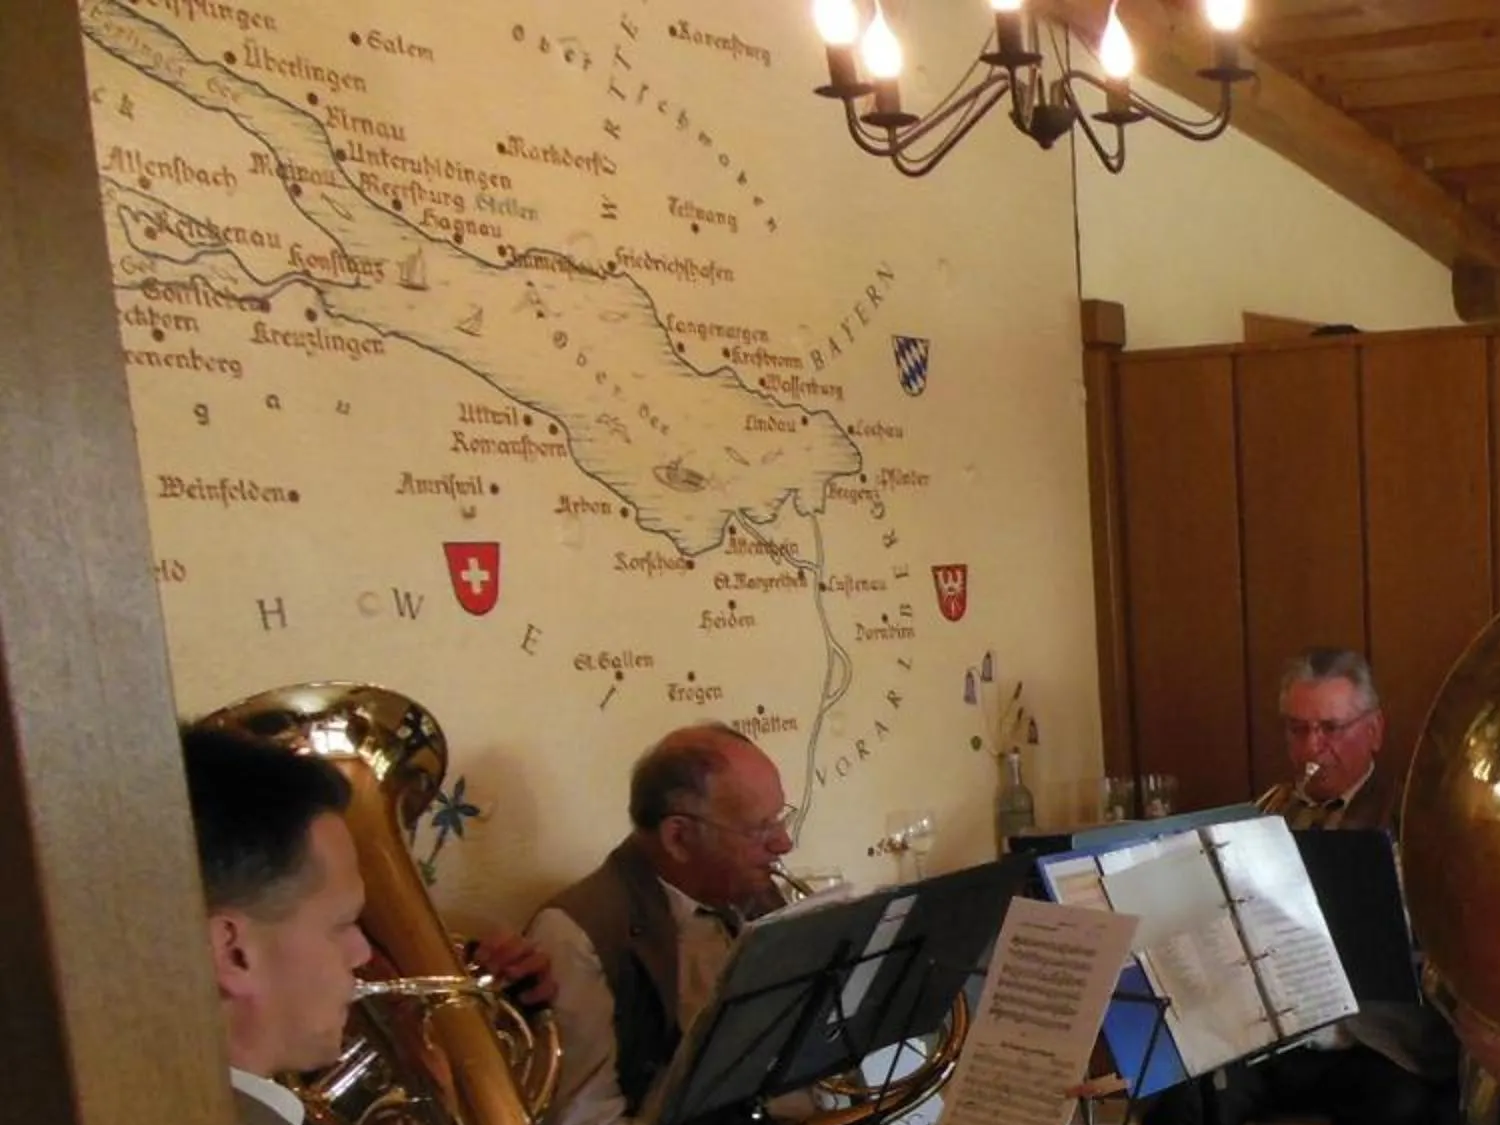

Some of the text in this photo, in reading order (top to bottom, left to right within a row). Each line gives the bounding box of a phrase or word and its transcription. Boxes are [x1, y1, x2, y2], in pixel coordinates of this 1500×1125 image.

[366, 29, 435, 61] Salem
[242, 37, 368, 95] Überlingen
[102, 146, 238, 193] Allensbach
[419, 208, 503, 240] Hagnau
[809, 260, 896, 372] BAYERN
[123, 346, 243, 380] renenberg
[156, 474, 288, 508] Weinfelden
